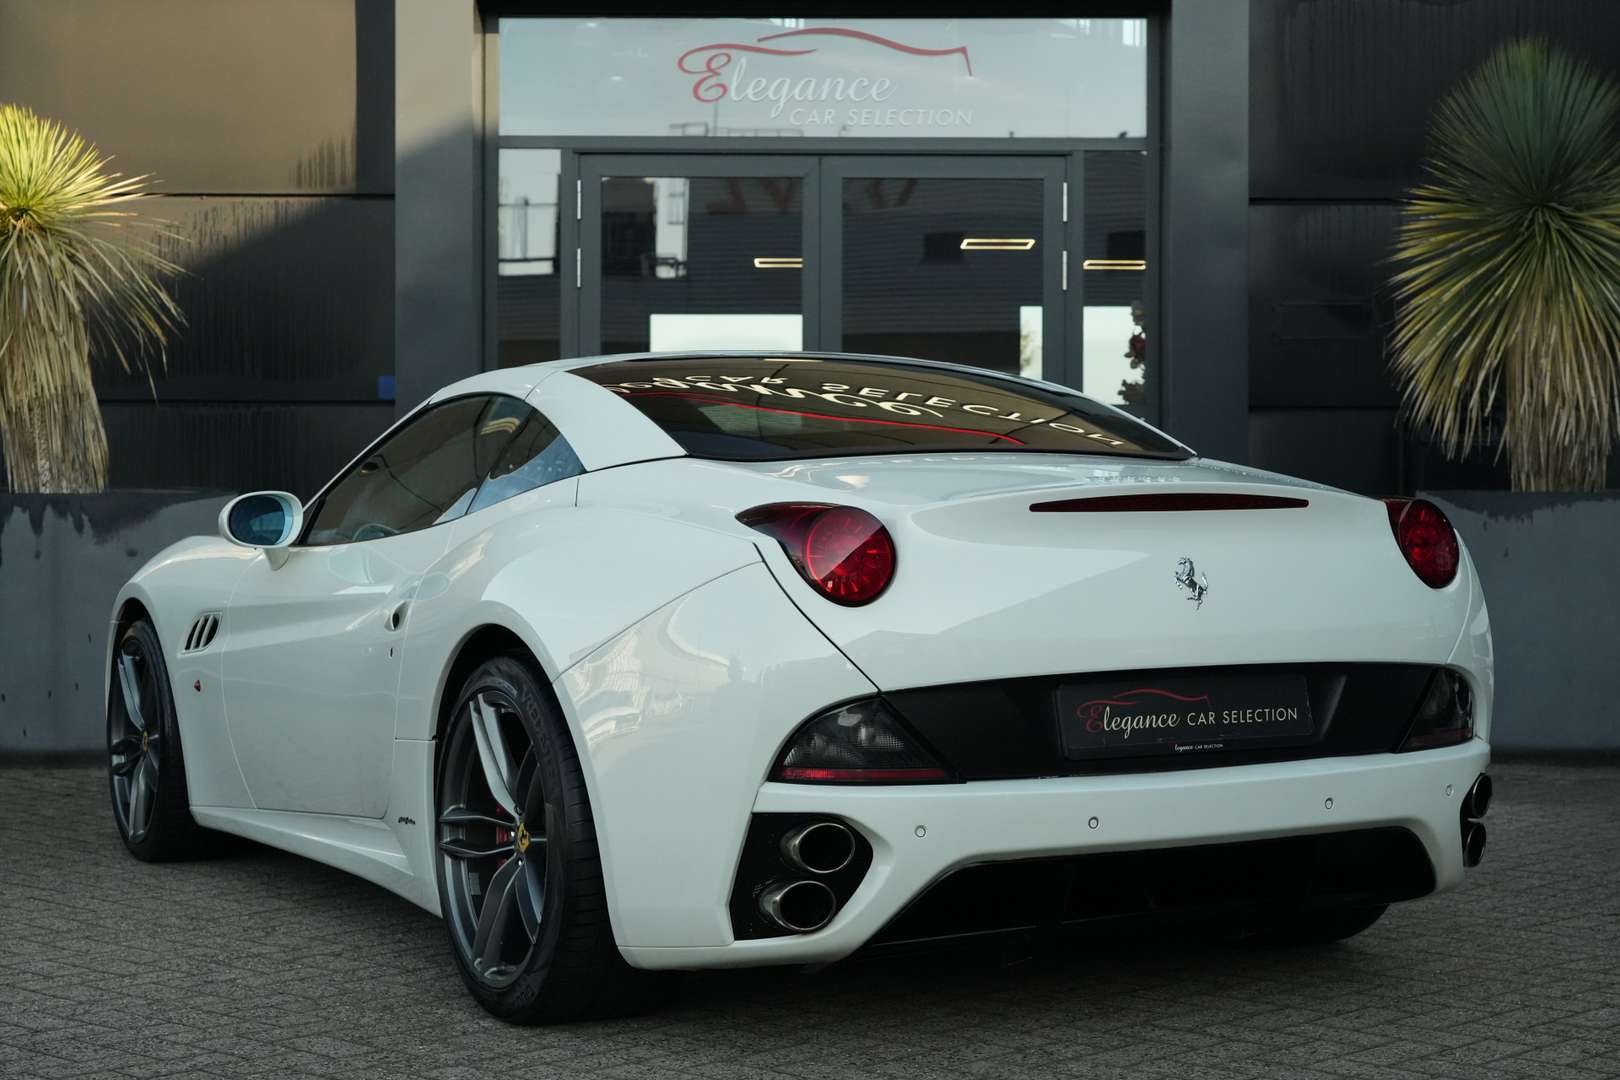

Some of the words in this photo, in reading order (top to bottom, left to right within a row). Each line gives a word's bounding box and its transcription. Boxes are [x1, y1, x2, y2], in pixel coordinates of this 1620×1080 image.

[677, 43, 897, 118] Elegance
[790, 108, 834, 126] CAR
[848, 108, 974, 126] SELECTION
[1077, 700, 1181, 739] Elegance
[1187, 710, 1216, 726] CAR
[1223, 707, 1298, 724] SELECTION
